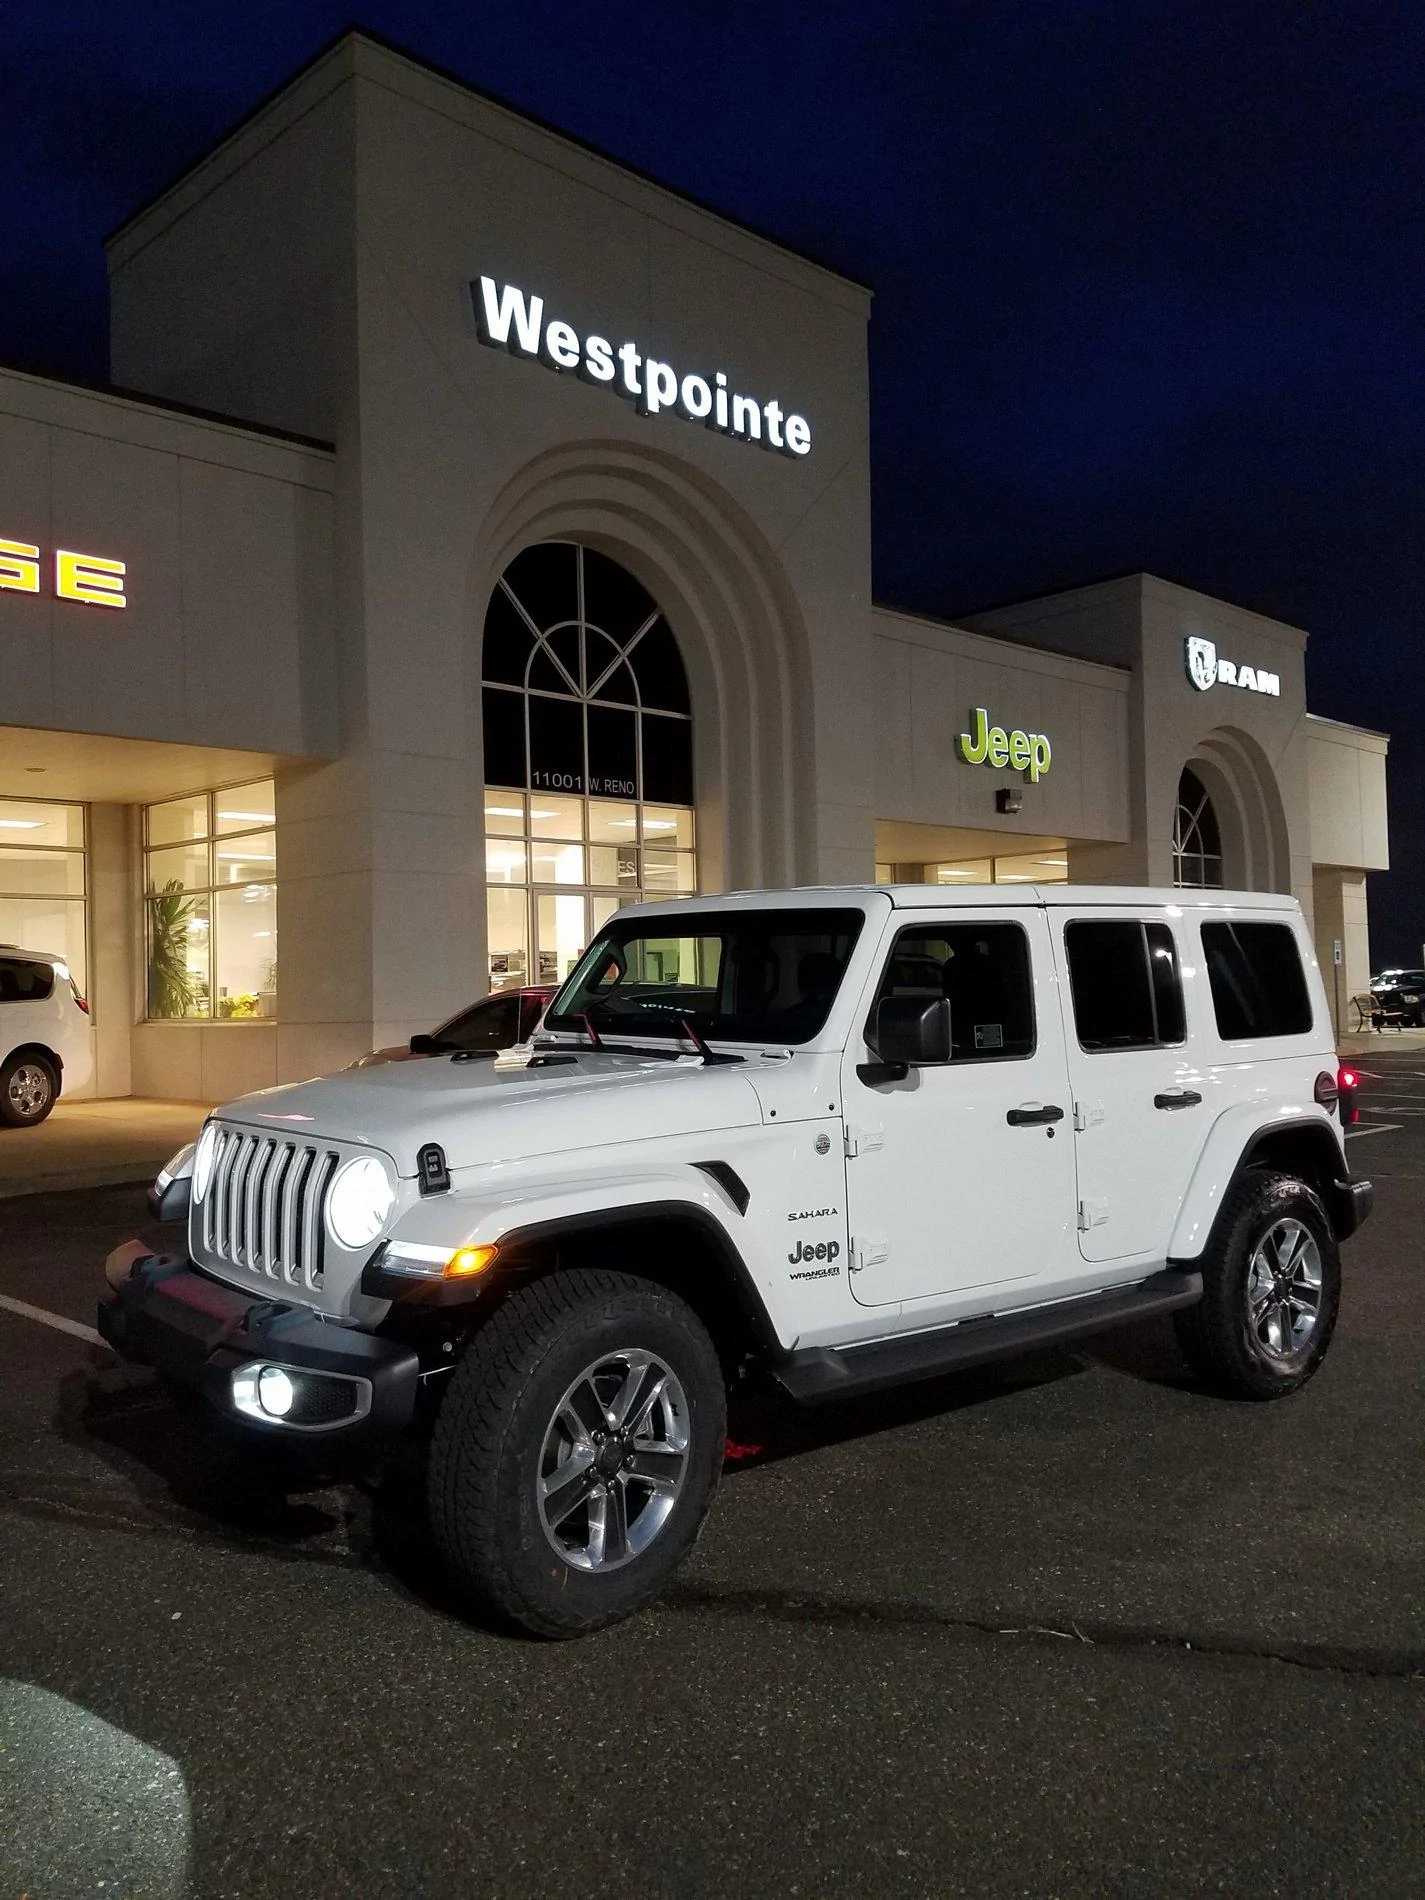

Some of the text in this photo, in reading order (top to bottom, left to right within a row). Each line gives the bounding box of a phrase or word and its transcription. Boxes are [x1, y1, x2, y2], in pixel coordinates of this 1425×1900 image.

[480, 276, 812, 456] Westpointe
[1218, 659, 1281, 697] RAM
[960, 707, 1052, 783] Jeep
[533, 771, 582, 790] 11001
[604, 779, 635, 795] RENO
[592, 859, 635, 874] SAES
[788, 1207, 839, 1221] SAHARA
[788, 1240, 840, 1264] Jeep
[789, 1266, 840, 1281] WRANGLER
